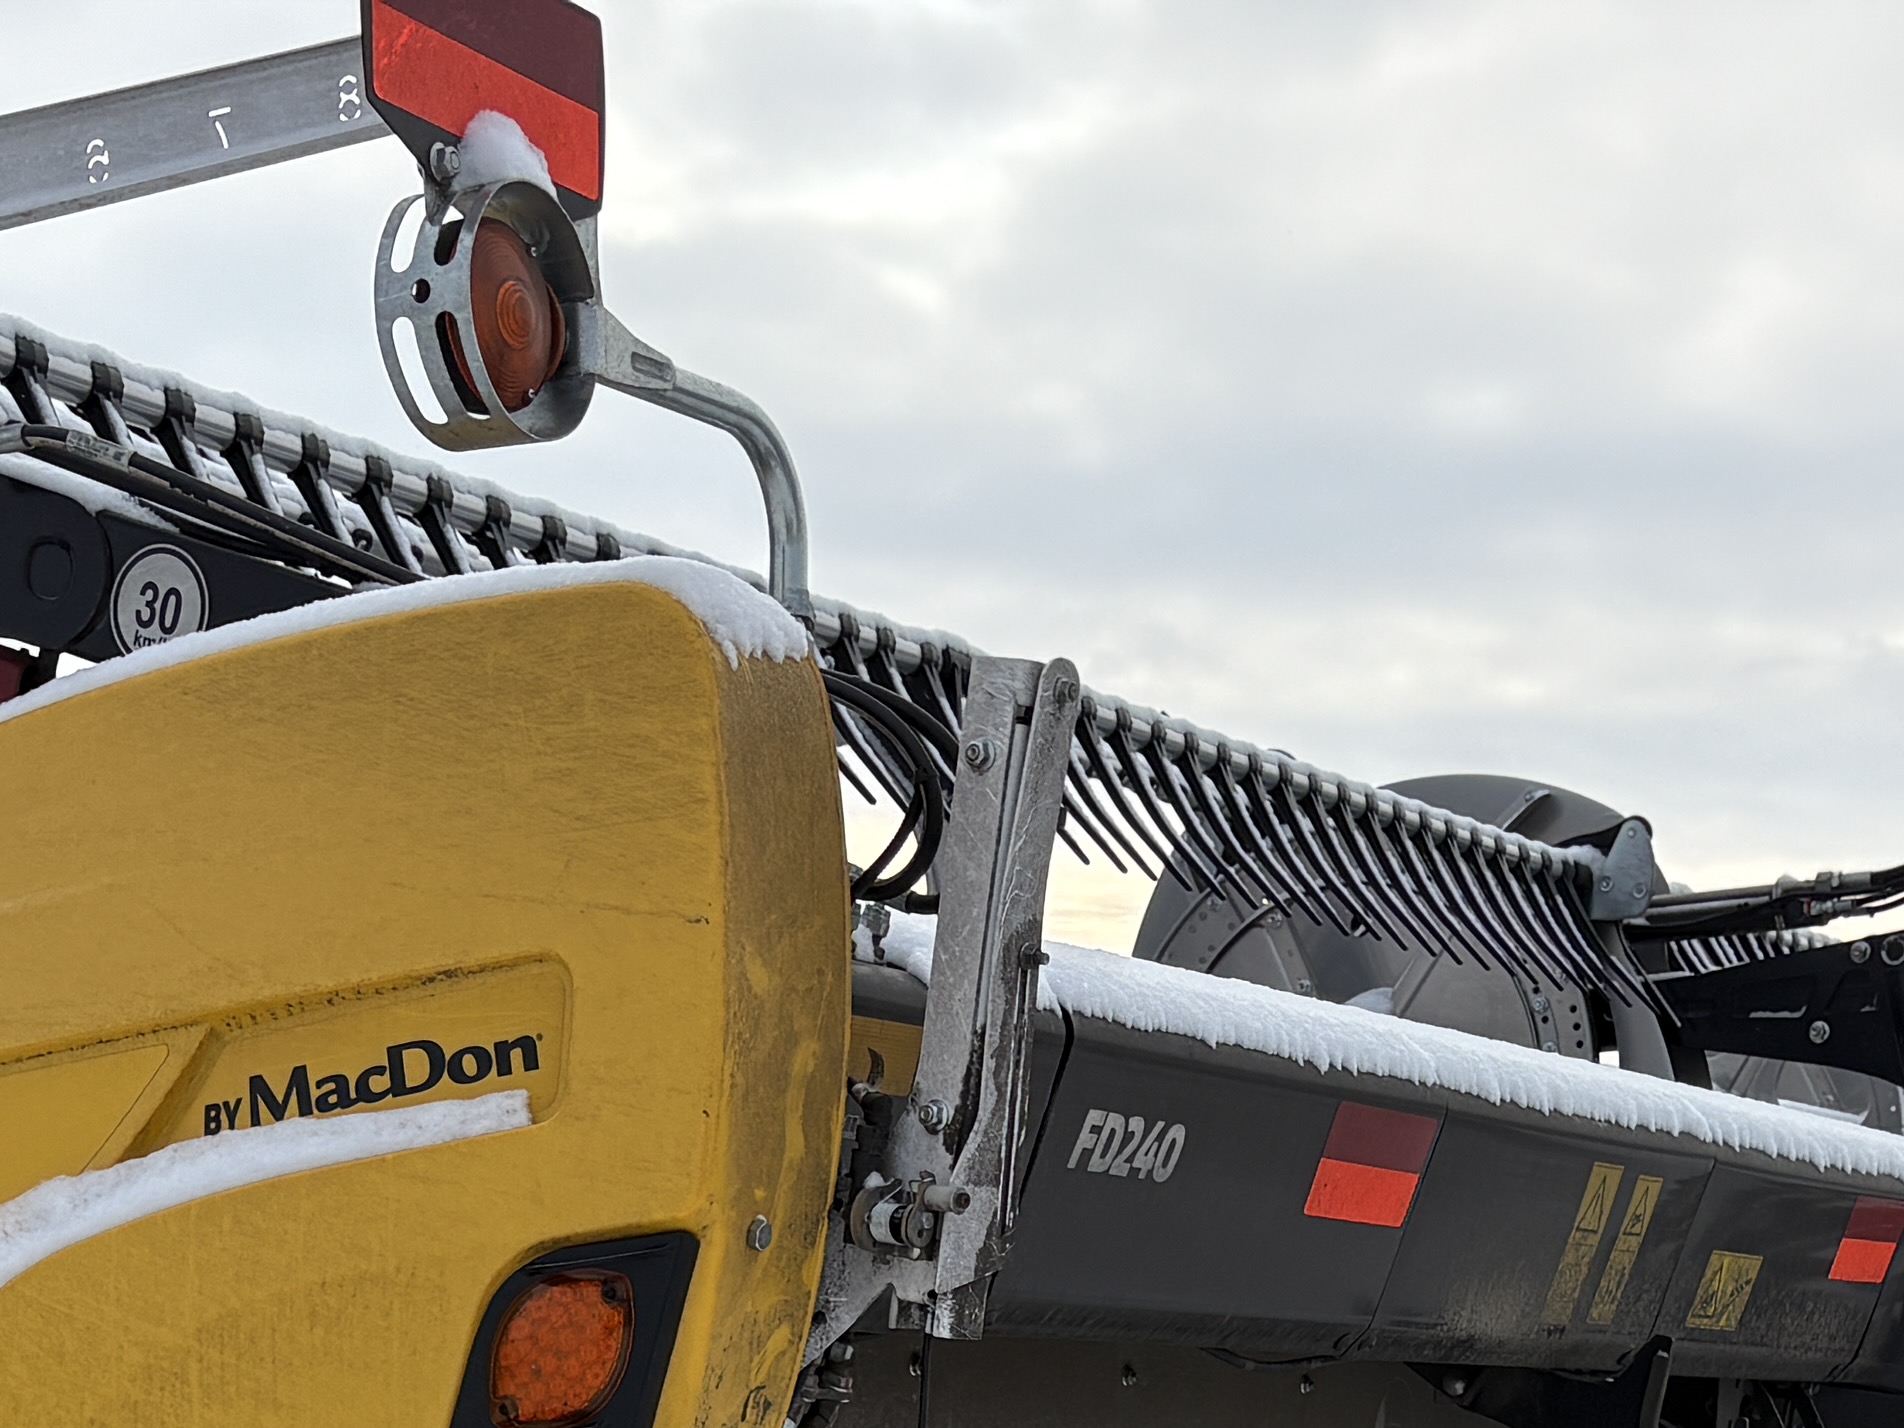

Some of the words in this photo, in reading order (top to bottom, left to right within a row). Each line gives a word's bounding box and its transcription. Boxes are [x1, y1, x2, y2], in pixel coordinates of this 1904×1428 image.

[133, 629, 169, 650] km
[135, 581, 183, 635] 30
[203, 1097, 243, 1137] BY
[248, 1034, 540, 1128] MacDon
[1067, 1108, 1186, 1183] FD240
